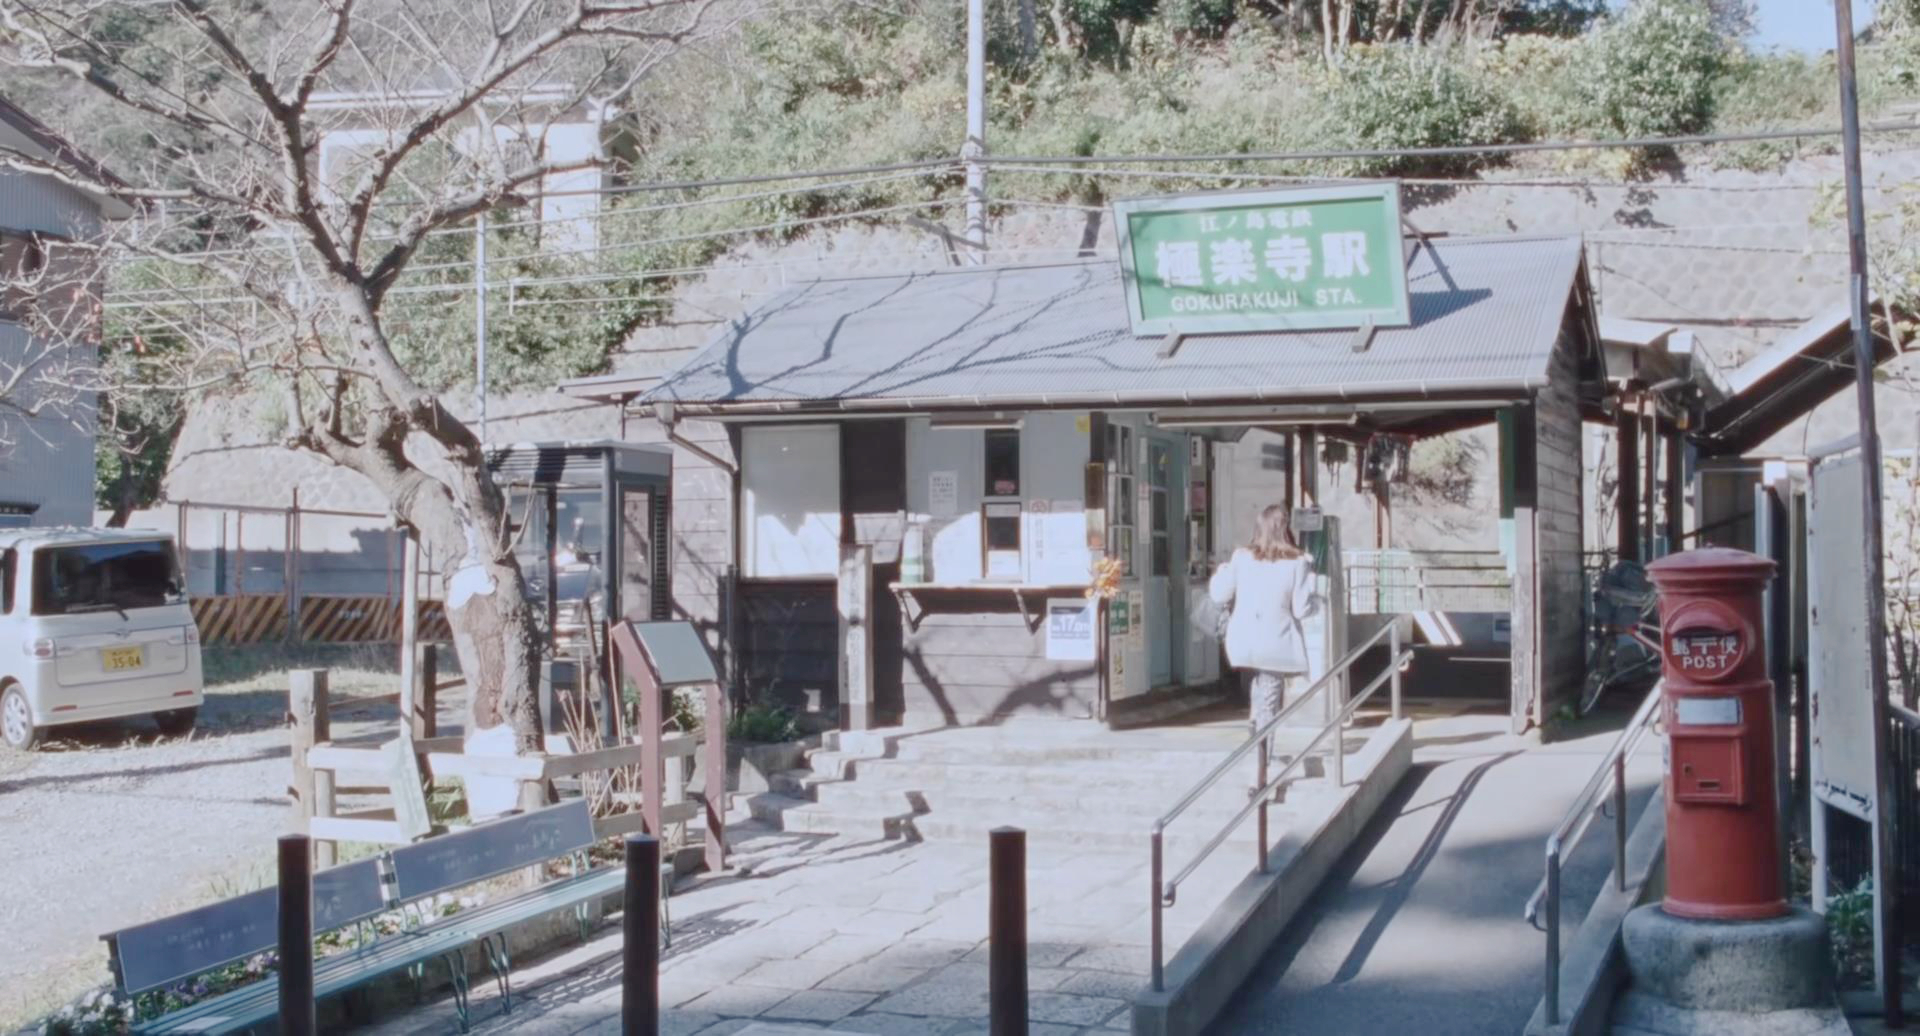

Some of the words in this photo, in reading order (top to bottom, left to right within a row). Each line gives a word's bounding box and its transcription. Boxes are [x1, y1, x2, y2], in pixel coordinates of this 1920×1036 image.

[1154, 231, 1370, 288] 極楽寺駅
[1170, 290, 1299, 313] GOKURAKUJI
[1314, 287, 1362, 306] STA.
[1682, 655, 1728, 669] POST
